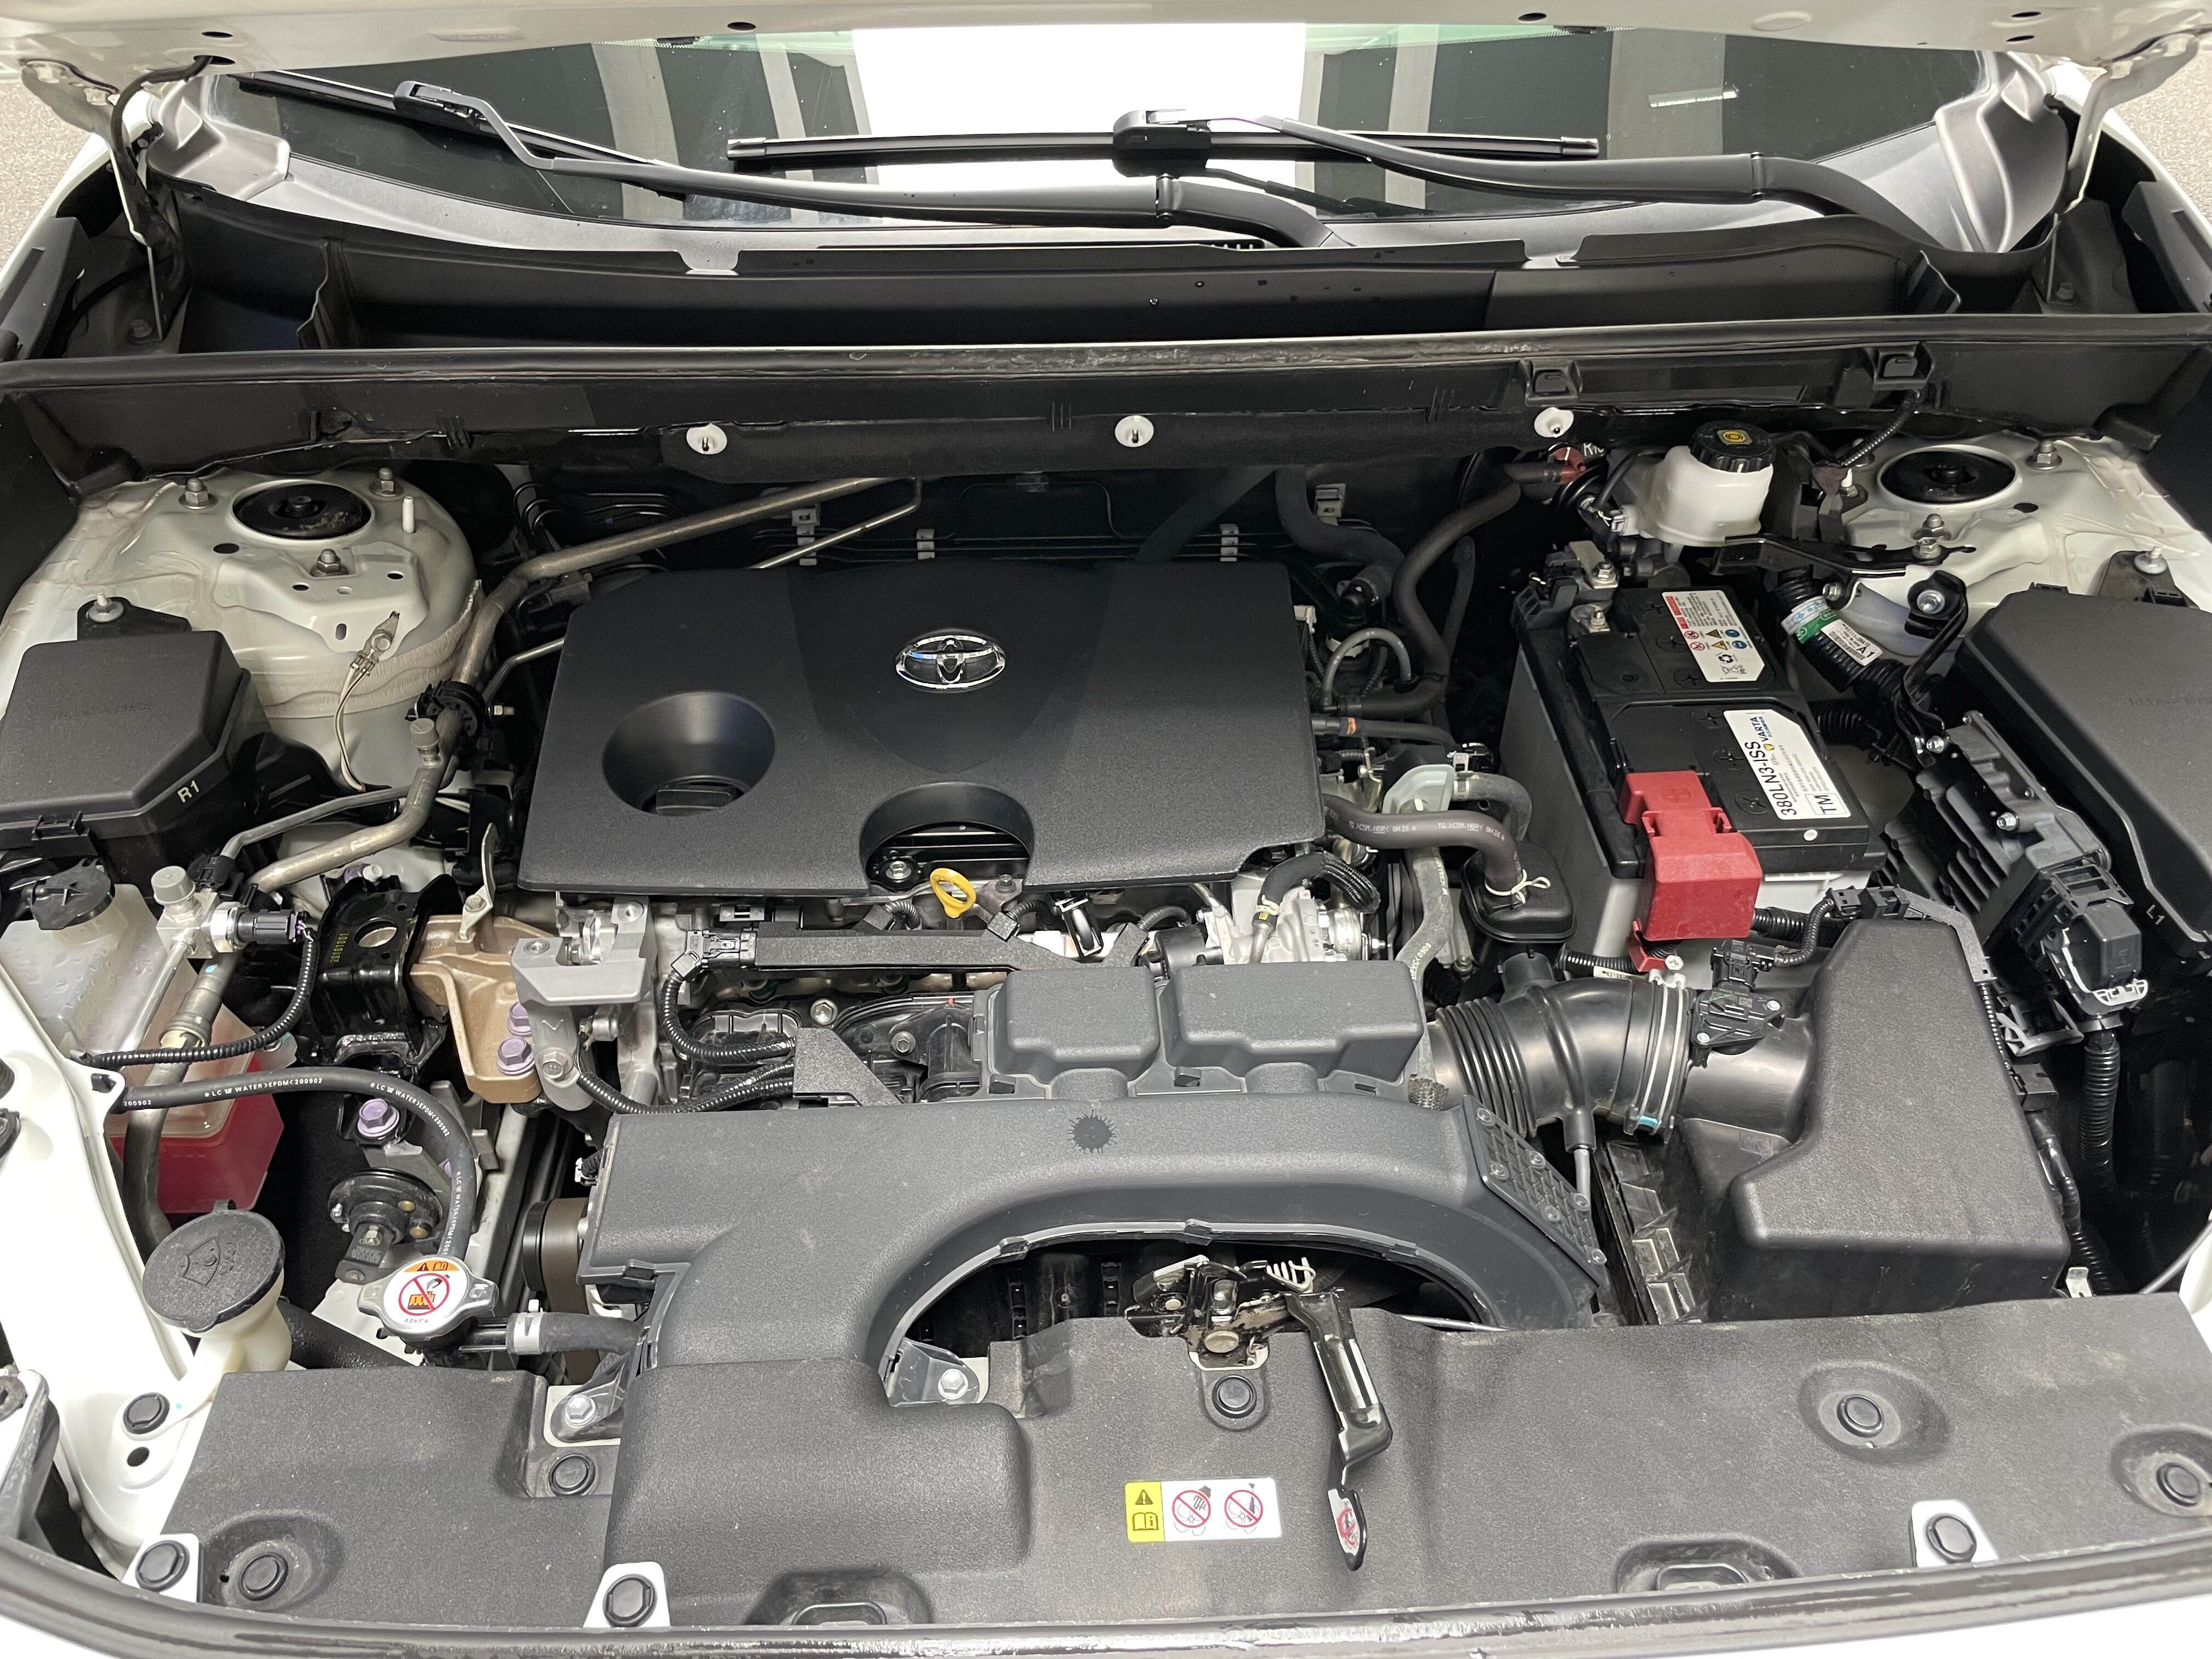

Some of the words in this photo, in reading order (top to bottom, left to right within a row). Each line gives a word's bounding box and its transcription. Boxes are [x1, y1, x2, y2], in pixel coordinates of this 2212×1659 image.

[1750, 716, 1769, 742] VARTA
[1744, 741, 1797, 816] 380LN3-ISS
[177, 780, 199, 803] R1
[1813, 795, 1837, 814] TM
[2146, 905, 2165, 925] L1
